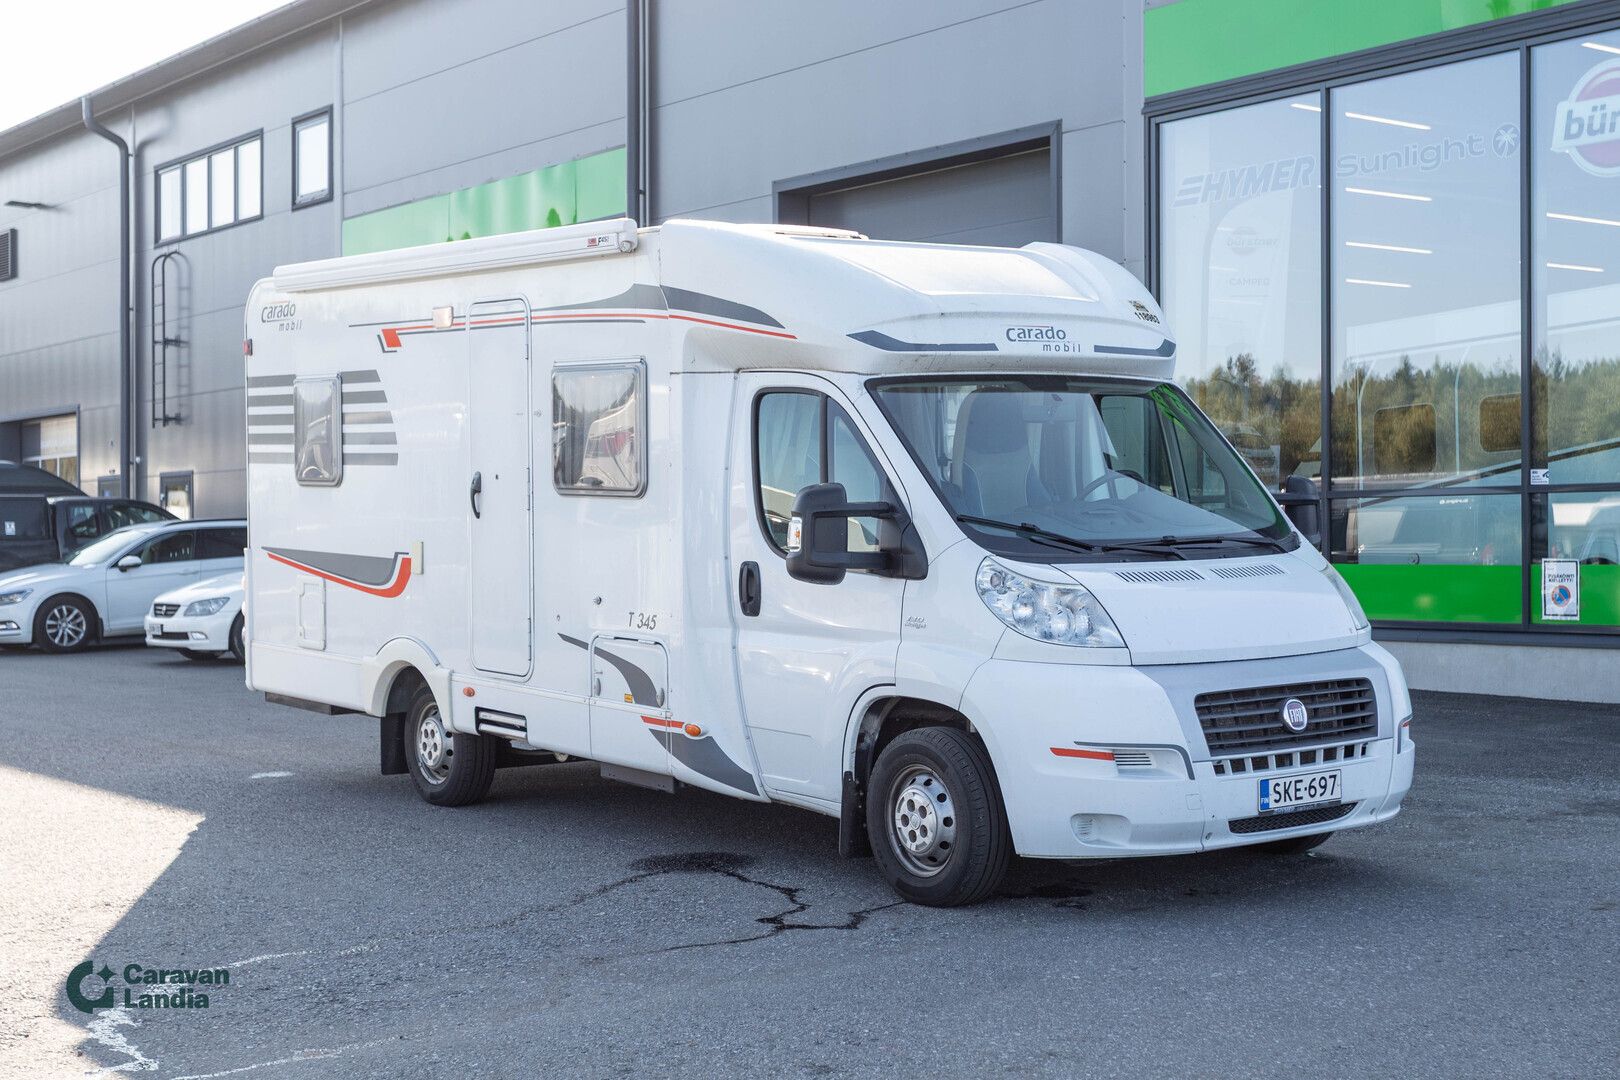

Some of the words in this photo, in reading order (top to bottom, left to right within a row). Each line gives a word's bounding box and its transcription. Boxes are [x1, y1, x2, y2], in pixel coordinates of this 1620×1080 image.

[1337, 134, 1484, 177] Sunlight
[1200, 155, 1315, 203] HYMER
[261, 299, 297, 323] carado
[278, 319, 303, 332] mobil
[1006, 326, 1067, 342] carado
[1042, 343, 1081, 353] mobil
[628, 611, 635, 627] T
[637, 612, 657, 631] 345
[1289, 707, 1303, 724] FIAT
[1273, 774, 1337, 804] SKE-697
